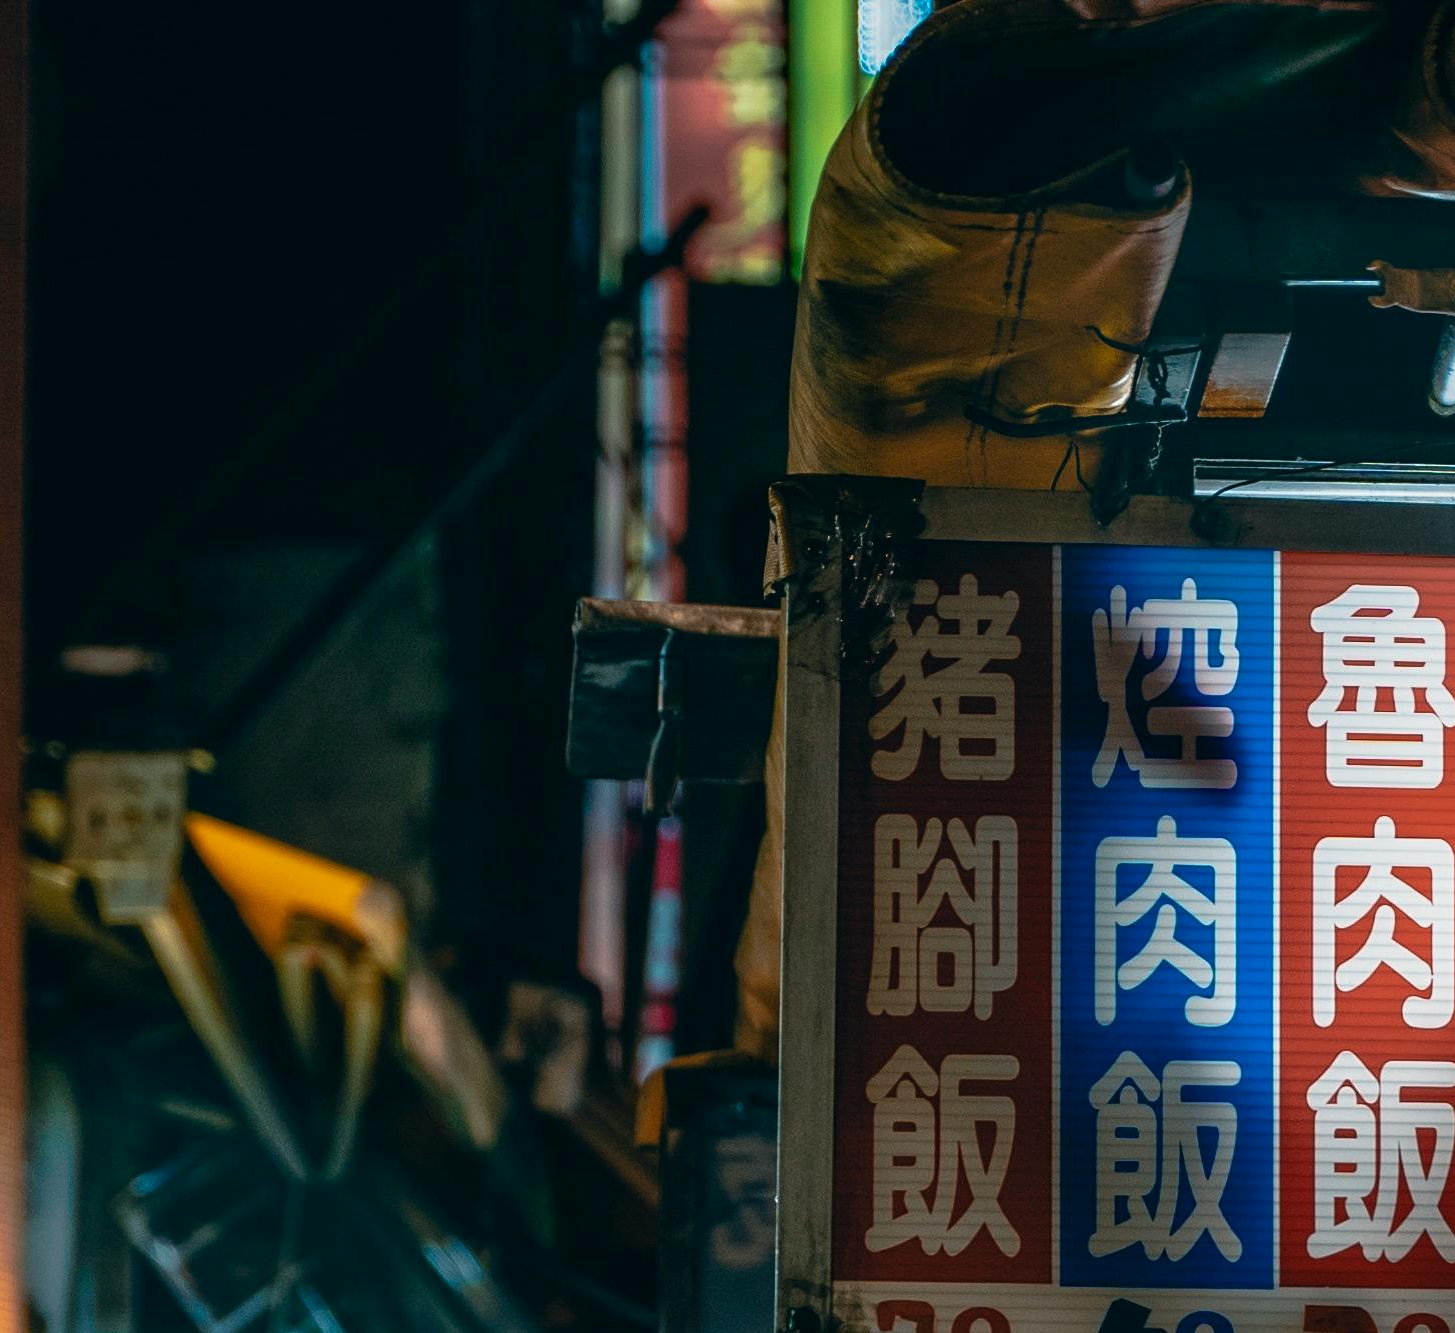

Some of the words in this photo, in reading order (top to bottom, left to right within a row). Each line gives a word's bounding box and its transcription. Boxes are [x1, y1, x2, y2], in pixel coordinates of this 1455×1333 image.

[864, 574, 1022, 1259] 豬腳飯
[1087, 577, 1243, 1262] 焢肉飯
